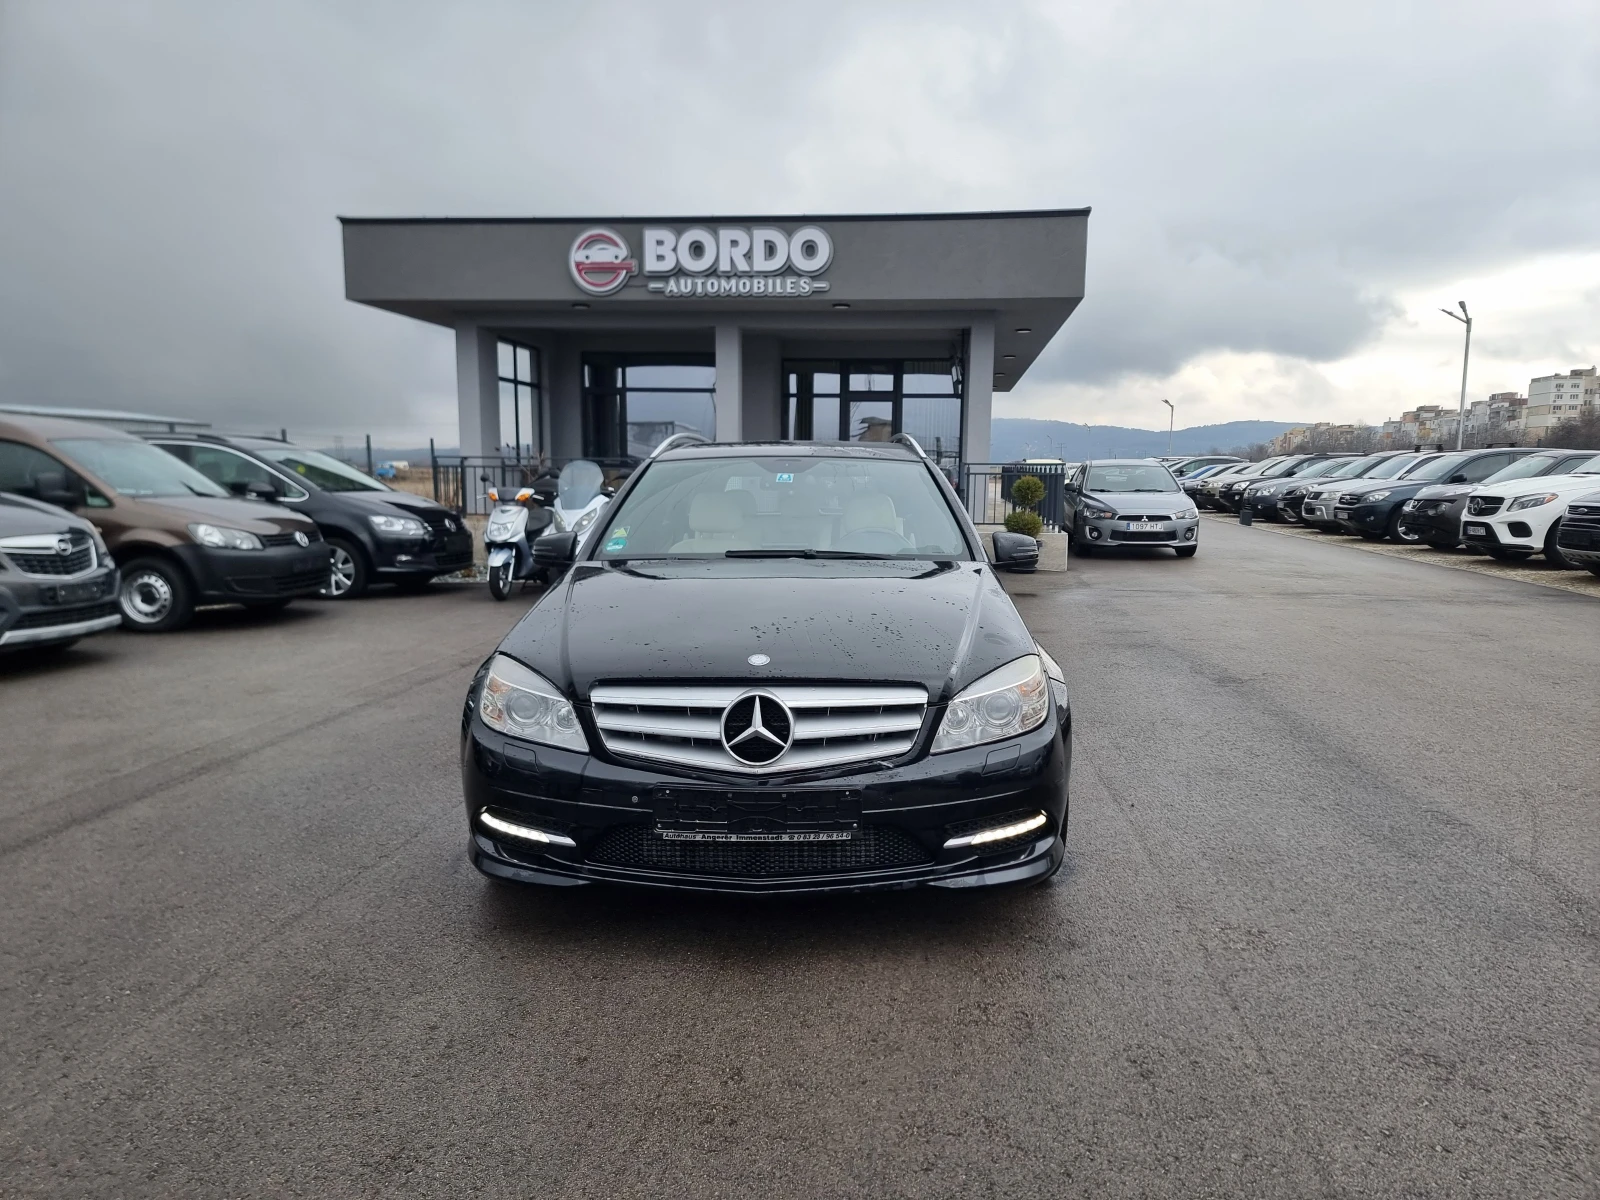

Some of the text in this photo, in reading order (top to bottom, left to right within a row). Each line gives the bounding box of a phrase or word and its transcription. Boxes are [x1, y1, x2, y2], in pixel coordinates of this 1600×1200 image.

[644, 227, 831, 273] BORDO
[666, 278, 811, 294] AUTOMOBILES
[664, 832, 697, 840] Autohaus
[701, 833, 733, 841] Angerer
[736, 833, 783, 841] Immenstadt
